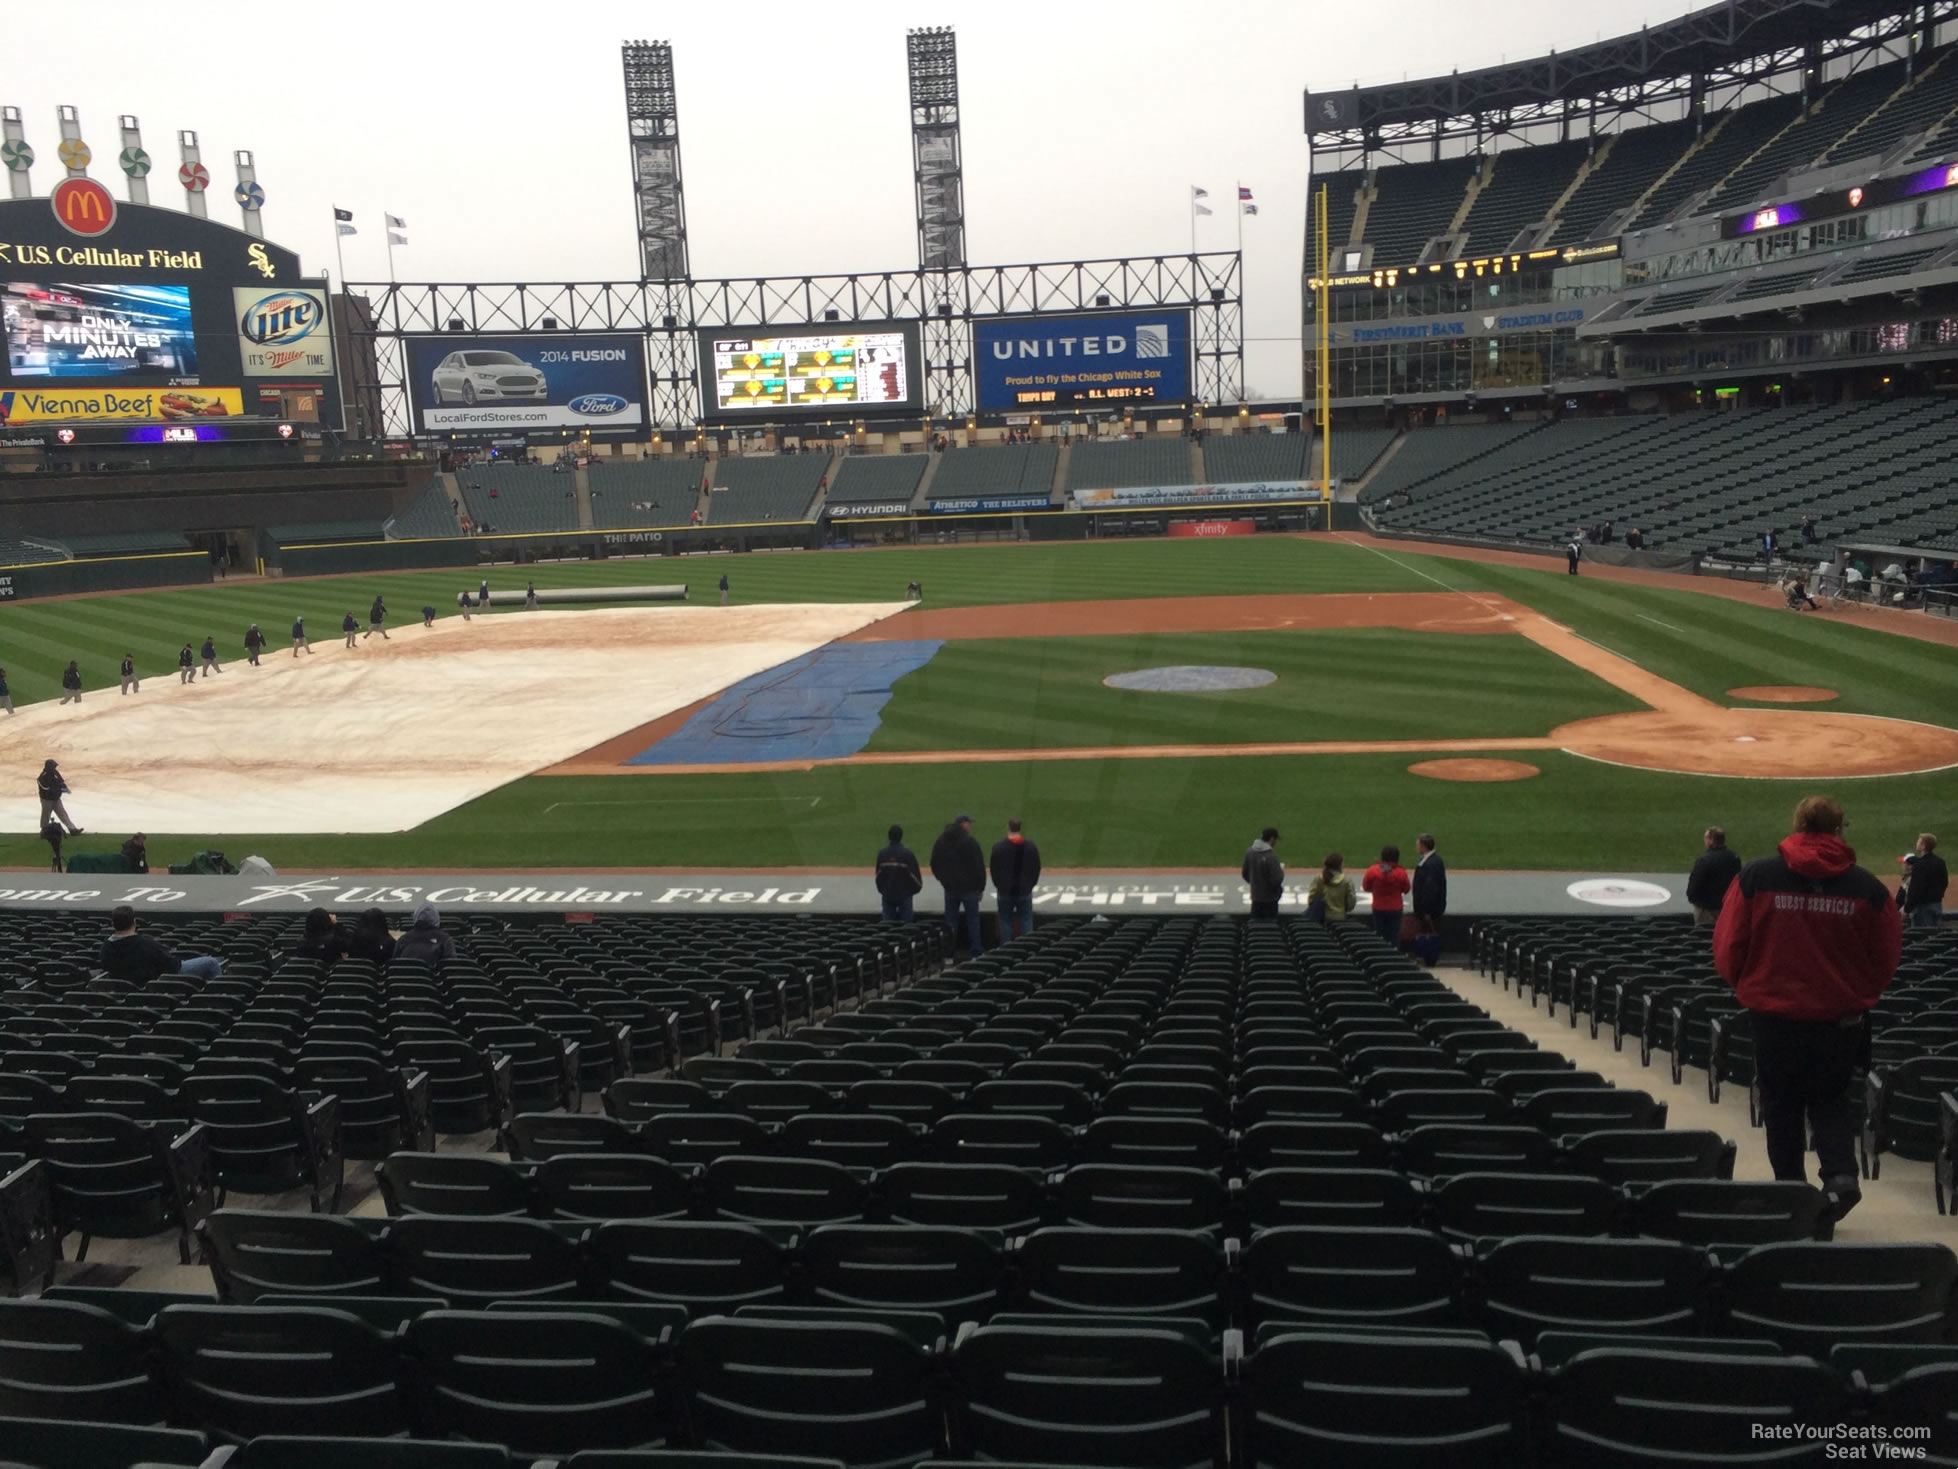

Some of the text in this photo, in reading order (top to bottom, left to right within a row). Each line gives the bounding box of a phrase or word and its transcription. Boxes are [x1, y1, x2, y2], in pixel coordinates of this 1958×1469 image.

[15, 245, 203, 269] U.S. Cellular Field
[265, 299, 294, 313] Miller
[82, 315, 131, 331] ONLY
[256, 301, 311, 345] Lite
[1555, 310, 1584, 322] CLUB
[43, 324, 161, 347] MINUTES
[82, 345, 137, 358] AWAY
[993, 335, 1127, 360] UNITED
[248, 351, 325, 368] IT'S Miller TIME
[540, 350, 626, 362] 2014 FUSION
[1005, 369, 1161, 385] Proud to fly the Chicago White Sox
[22, 394, 153, 417] Vienna Beef
[580, 397, 616, 413] Ford
[434, 413, 547, 424] LocalFordStores.com
[851, 504, 907, 514] HYUNDAI
[934, 499, 1047, 510] ATHLETICO THE BELIEVERS
[1194, 523, 1228, 535] xfinity
[604, 532, 663, 543] THE PATIO
[112, 886, 187, 903] To
[334, 886, 413, 903] U.S.
[425, 886, 644, 904] Cellular
[651, 887, 822, 904] Field
[1774, 895, 1856, 915] GUEST SERVICES
